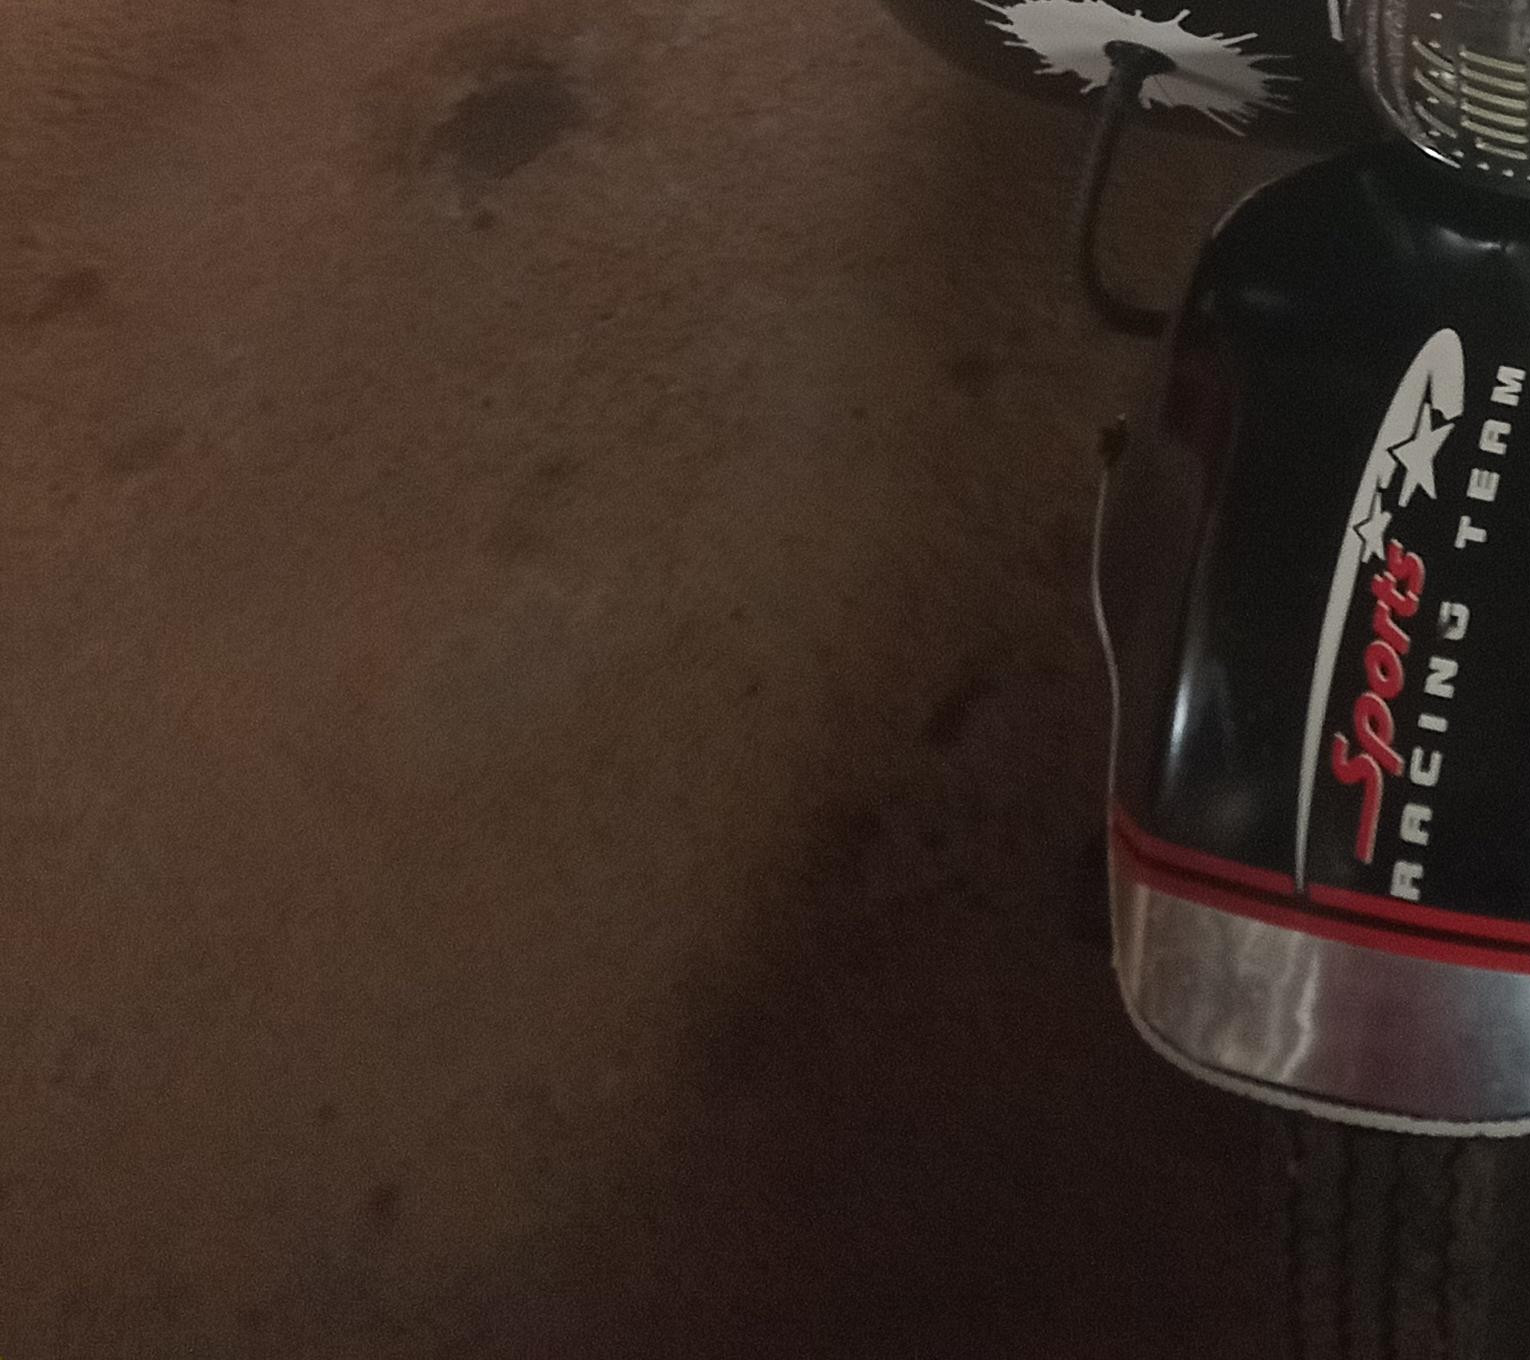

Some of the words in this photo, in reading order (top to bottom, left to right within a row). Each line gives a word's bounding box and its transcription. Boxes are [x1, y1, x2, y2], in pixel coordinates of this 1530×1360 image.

[1332, 539, 1426, 864] Sports
[1389, 600, 1471, 902] RACING
[1454, 365, 1527, 549] TEAM
